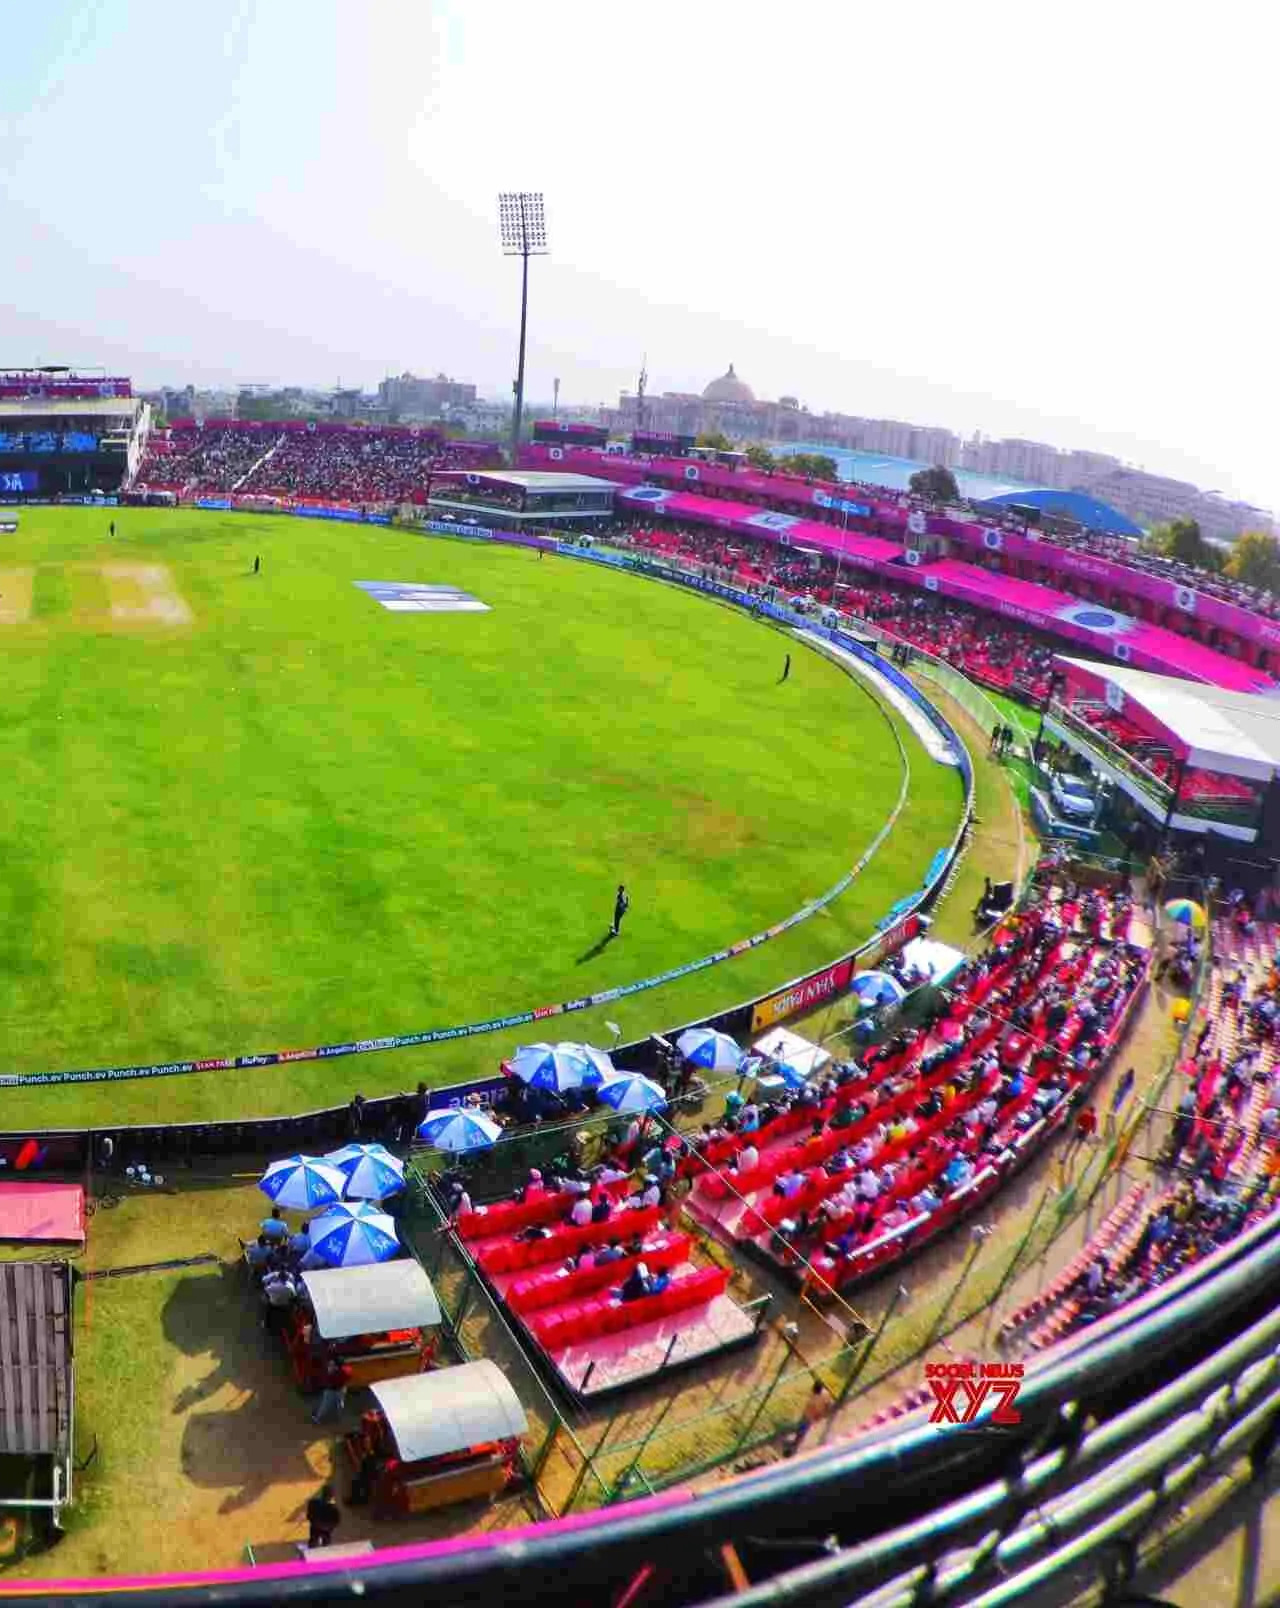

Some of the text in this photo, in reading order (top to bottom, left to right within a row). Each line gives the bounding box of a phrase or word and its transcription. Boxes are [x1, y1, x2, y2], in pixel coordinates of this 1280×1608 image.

[63, 1071, 106, 1082] Punch.ev
[108, 1068, 150, 1079] Punch.ev
[151, 1063, 193, 1074] Punch.ev
